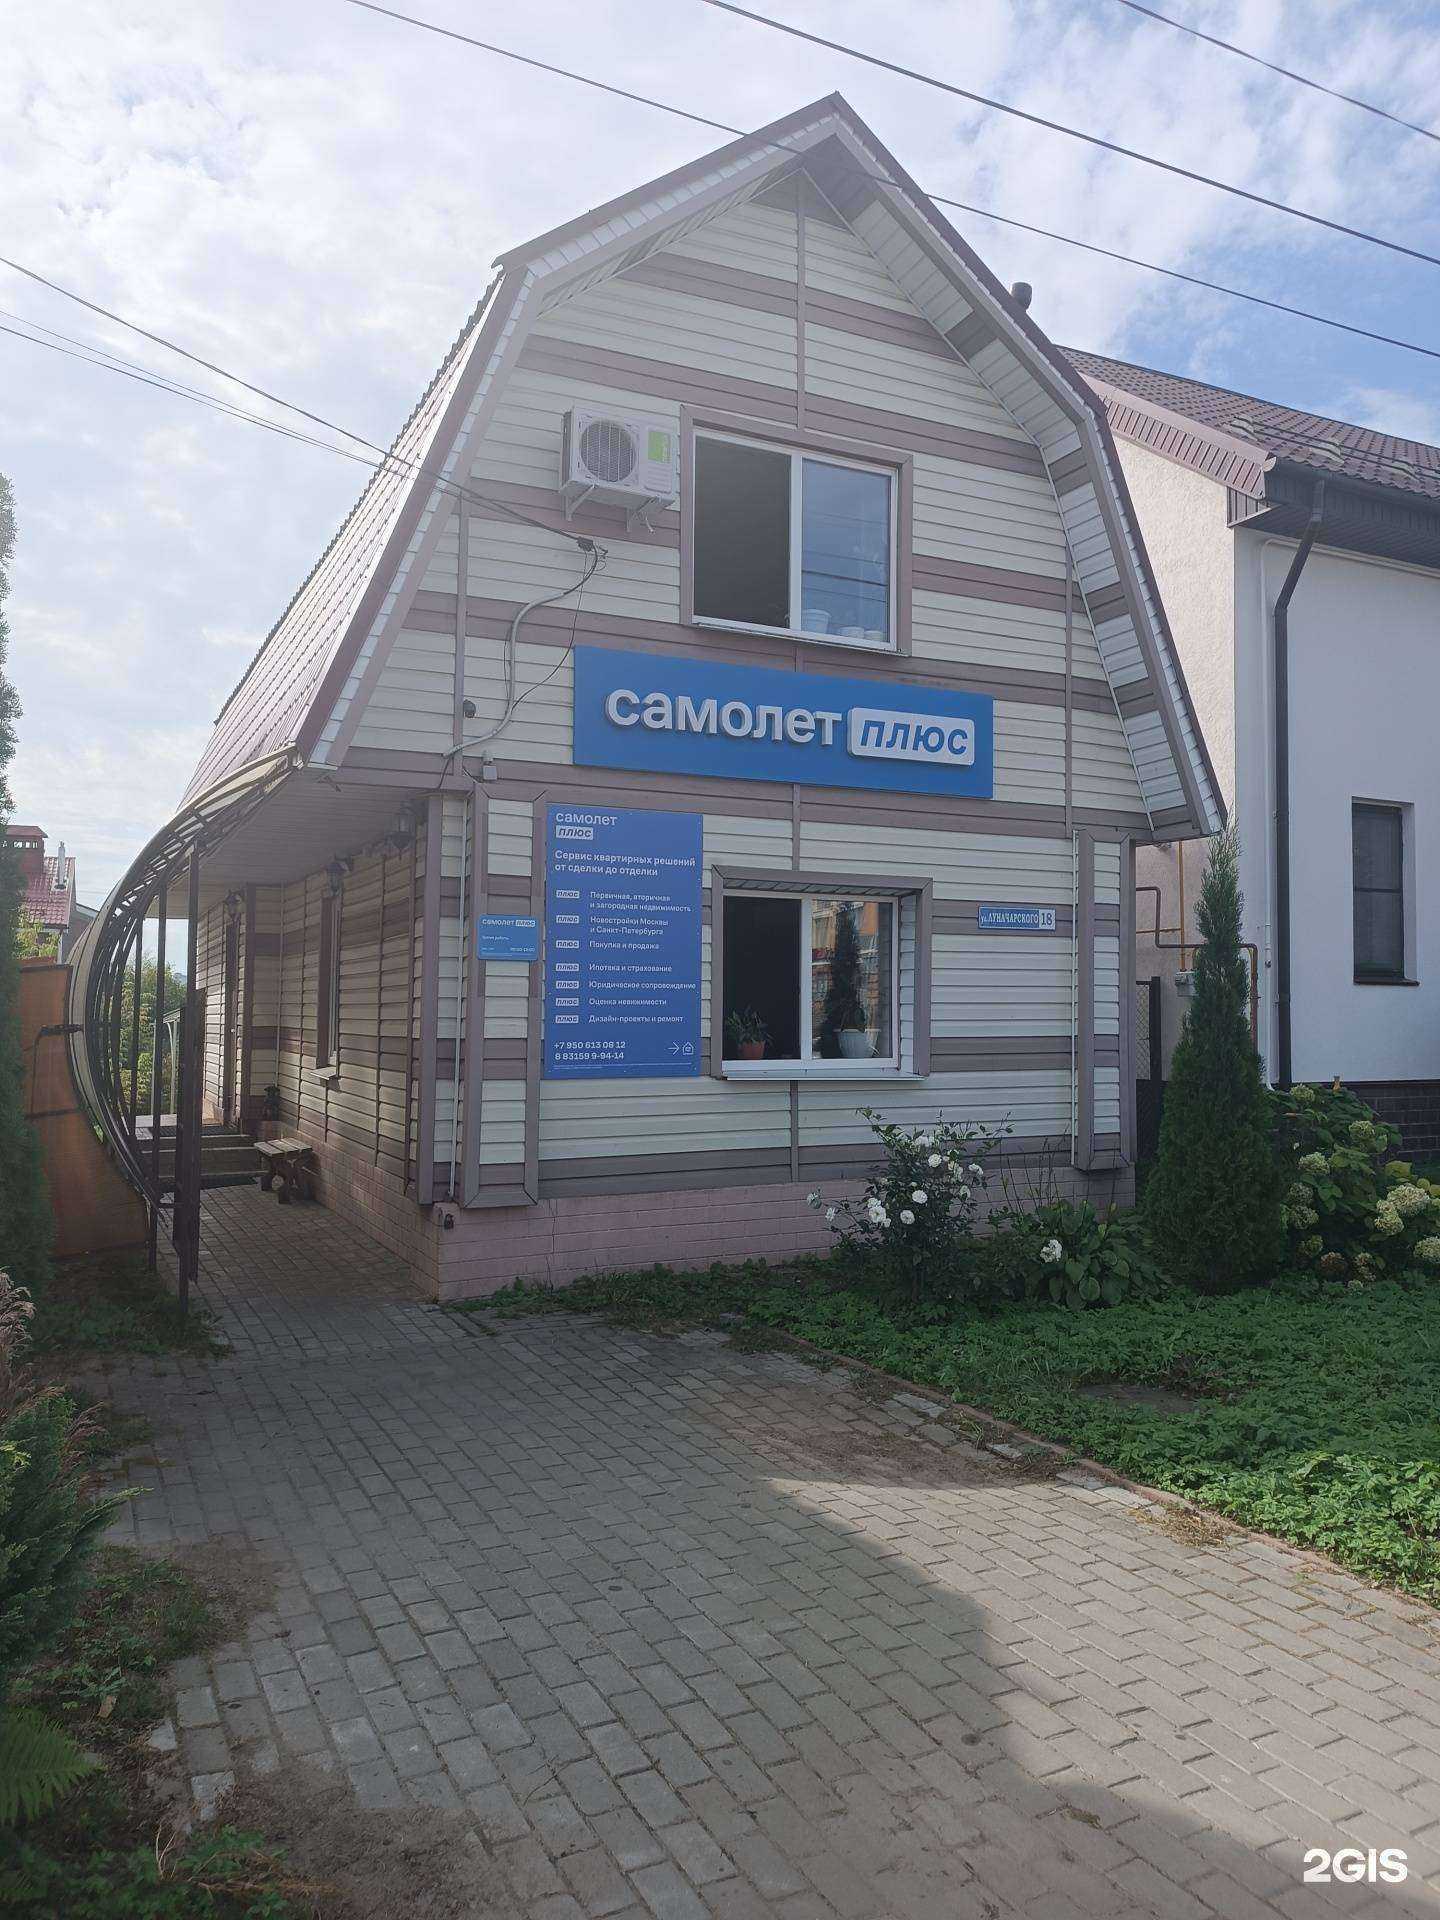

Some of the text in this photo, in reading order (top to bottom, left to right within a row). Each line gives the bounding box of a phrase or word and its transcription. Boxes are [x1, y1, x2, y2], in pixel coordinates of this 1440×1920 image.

[605, 688, 969, 756] самолет плюс
[556, 812, 618, 826] самолет
[557, 827, 593, 839] плюс
[555, 850, 696, 867] Сервис квартирных решений
[555, 864, 659, 877] от сделки до отделки
[557, 890, 579, 898] плюс
[633, 894, 671, 902] вторичная
[596, 903, 639, 911] загородная
[640, 904, 692, 912] недвижимость
[557, 915, 579, 924] плюс
[590, 916, 669, 926] Новостройки Москвы
[988, 912, 1039, 924] ЛУНАЧАРСКОГО
[1041, 912, 1053, 926] 18
[596, 926, 664, 936] Санкт-Петербурга
[557, 940, 579, 949] плюс
[589, 940, 621, 949] Покупка
[628, 943, 660, 951] продажа
[589, 963, 620, 971] Ипотека
[588, 980, 696, 990] Юридическое сопровождение
[588, 998, 617, 1006] Оценка
[588, 1014, 650, 1023] Дизайн-проекты
[657, 1016, 684, 1024] ремонт
[554, 1041, 565, 1049] +7
[566, 1041, 583, 1049] 950
[615, 1041, 626, 1049] 12
